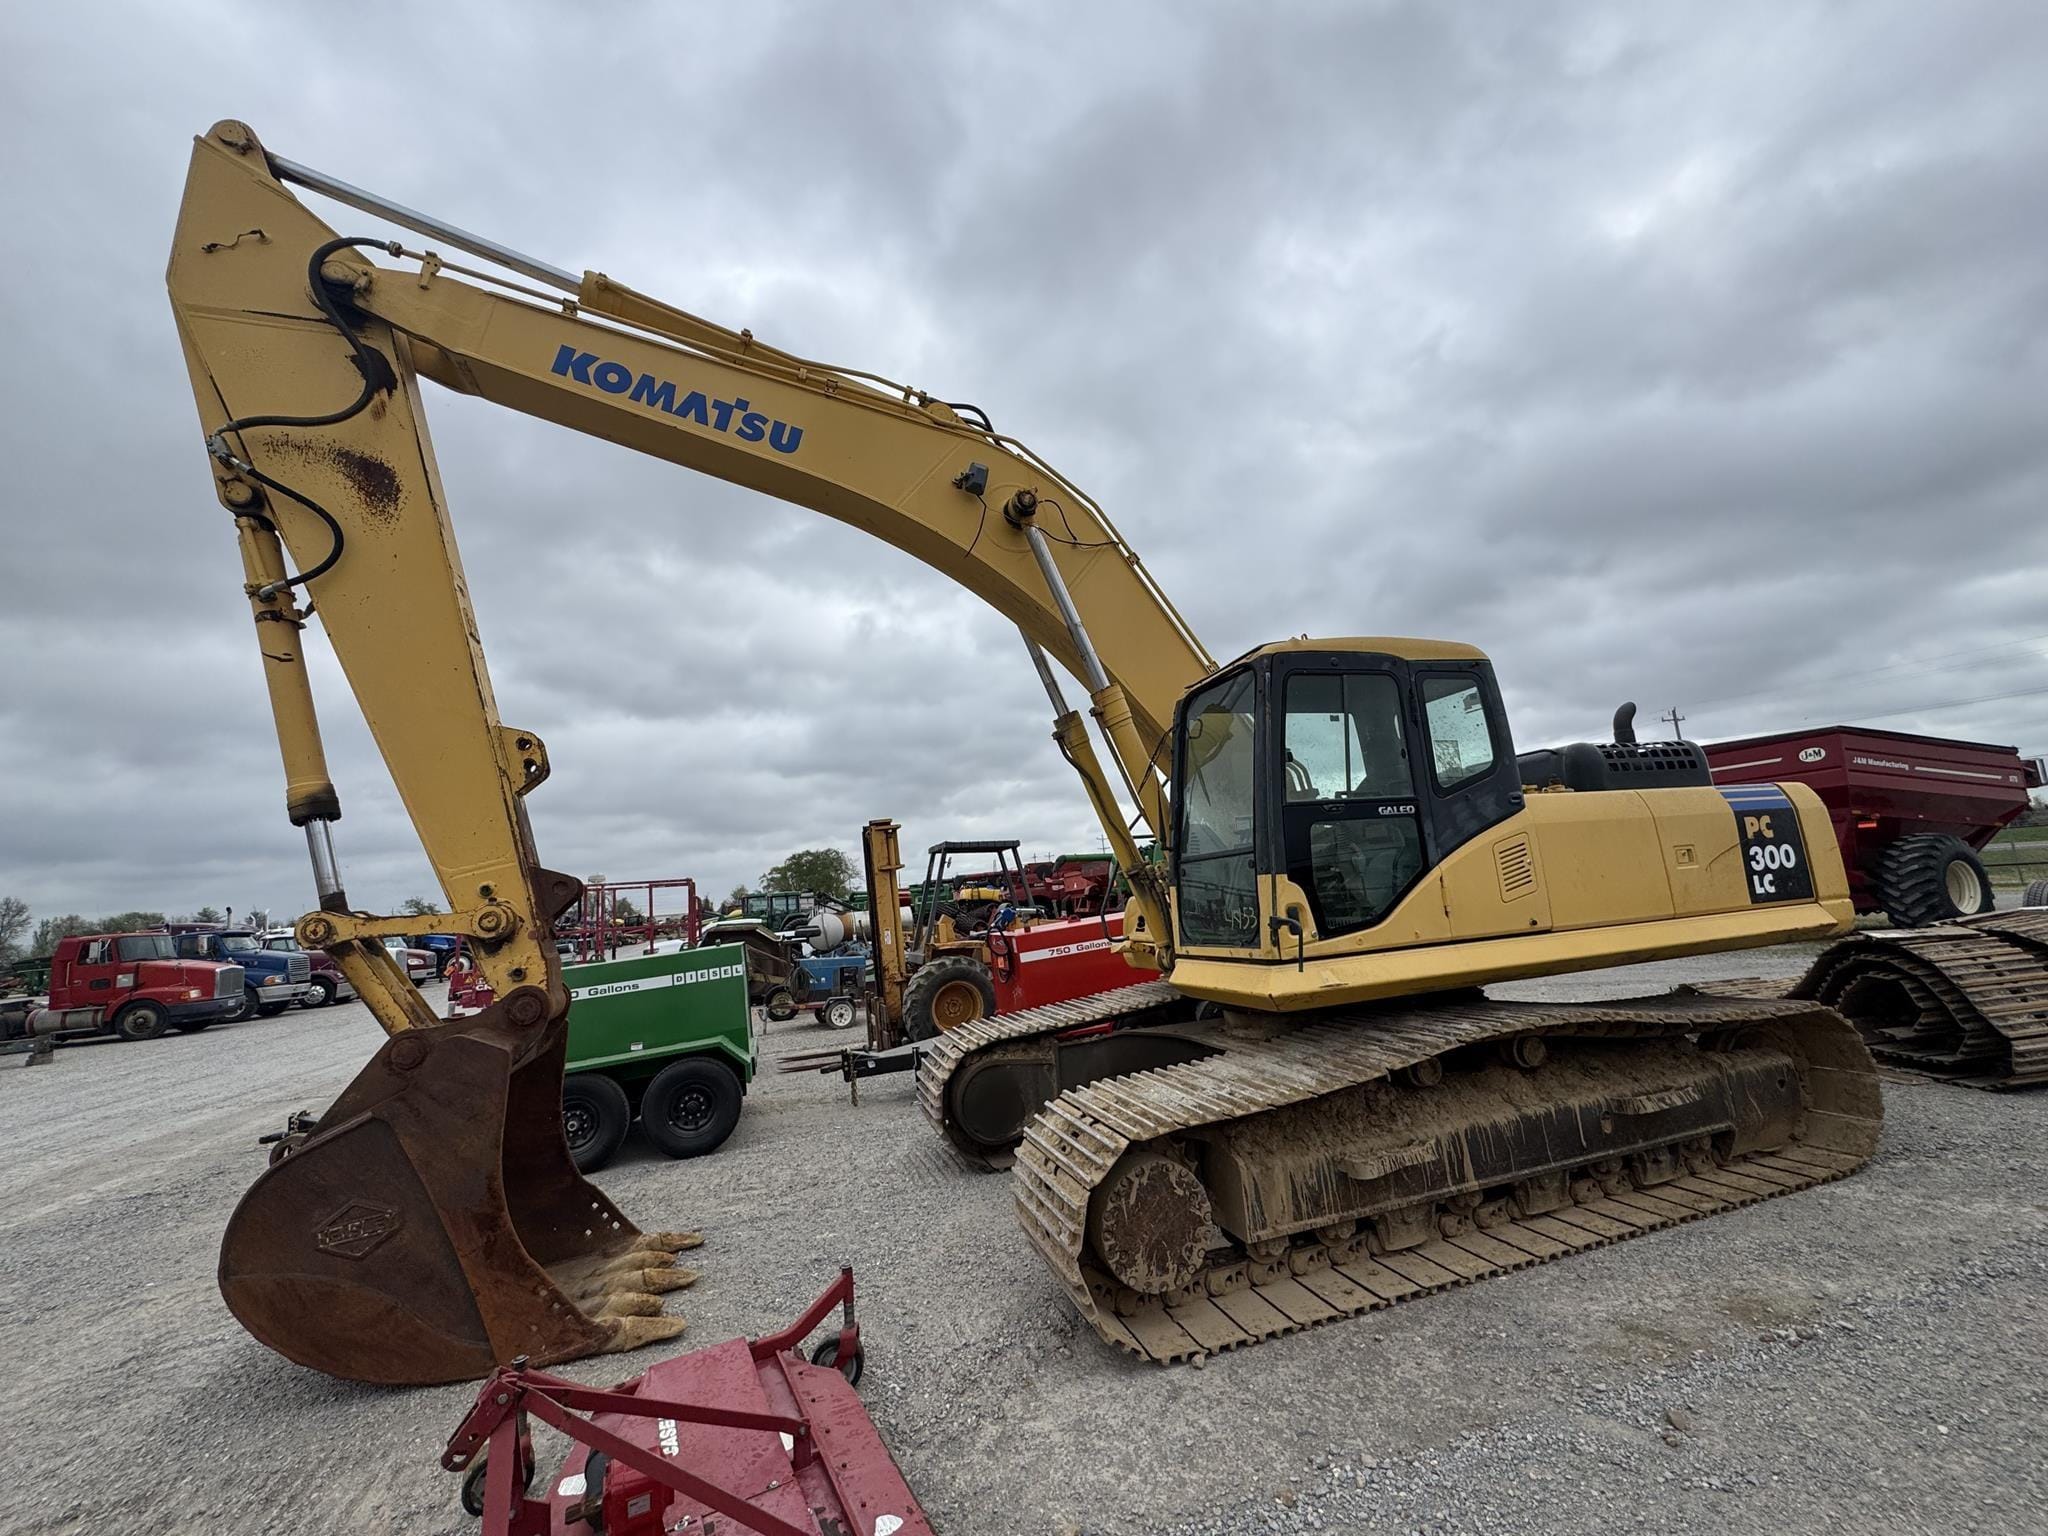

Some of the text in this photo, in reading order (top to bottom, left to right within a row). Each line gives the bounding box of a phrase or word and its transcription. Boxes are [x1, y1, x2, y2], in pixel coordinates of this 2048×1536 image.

[551, 344, 804, 454] KOMATSU
[1378, 805, 1416, 815] GALEO
[1743, 815, 1775, 839] PC
[1749, 843, 1796, 871] 300
[1752, 873, 1776, 894] LC
[1048, 941, 1113, 956] 750 Gallons
[588, 982, 640, 997] Gallons
[675, 966, 741, 983] DIESEL
